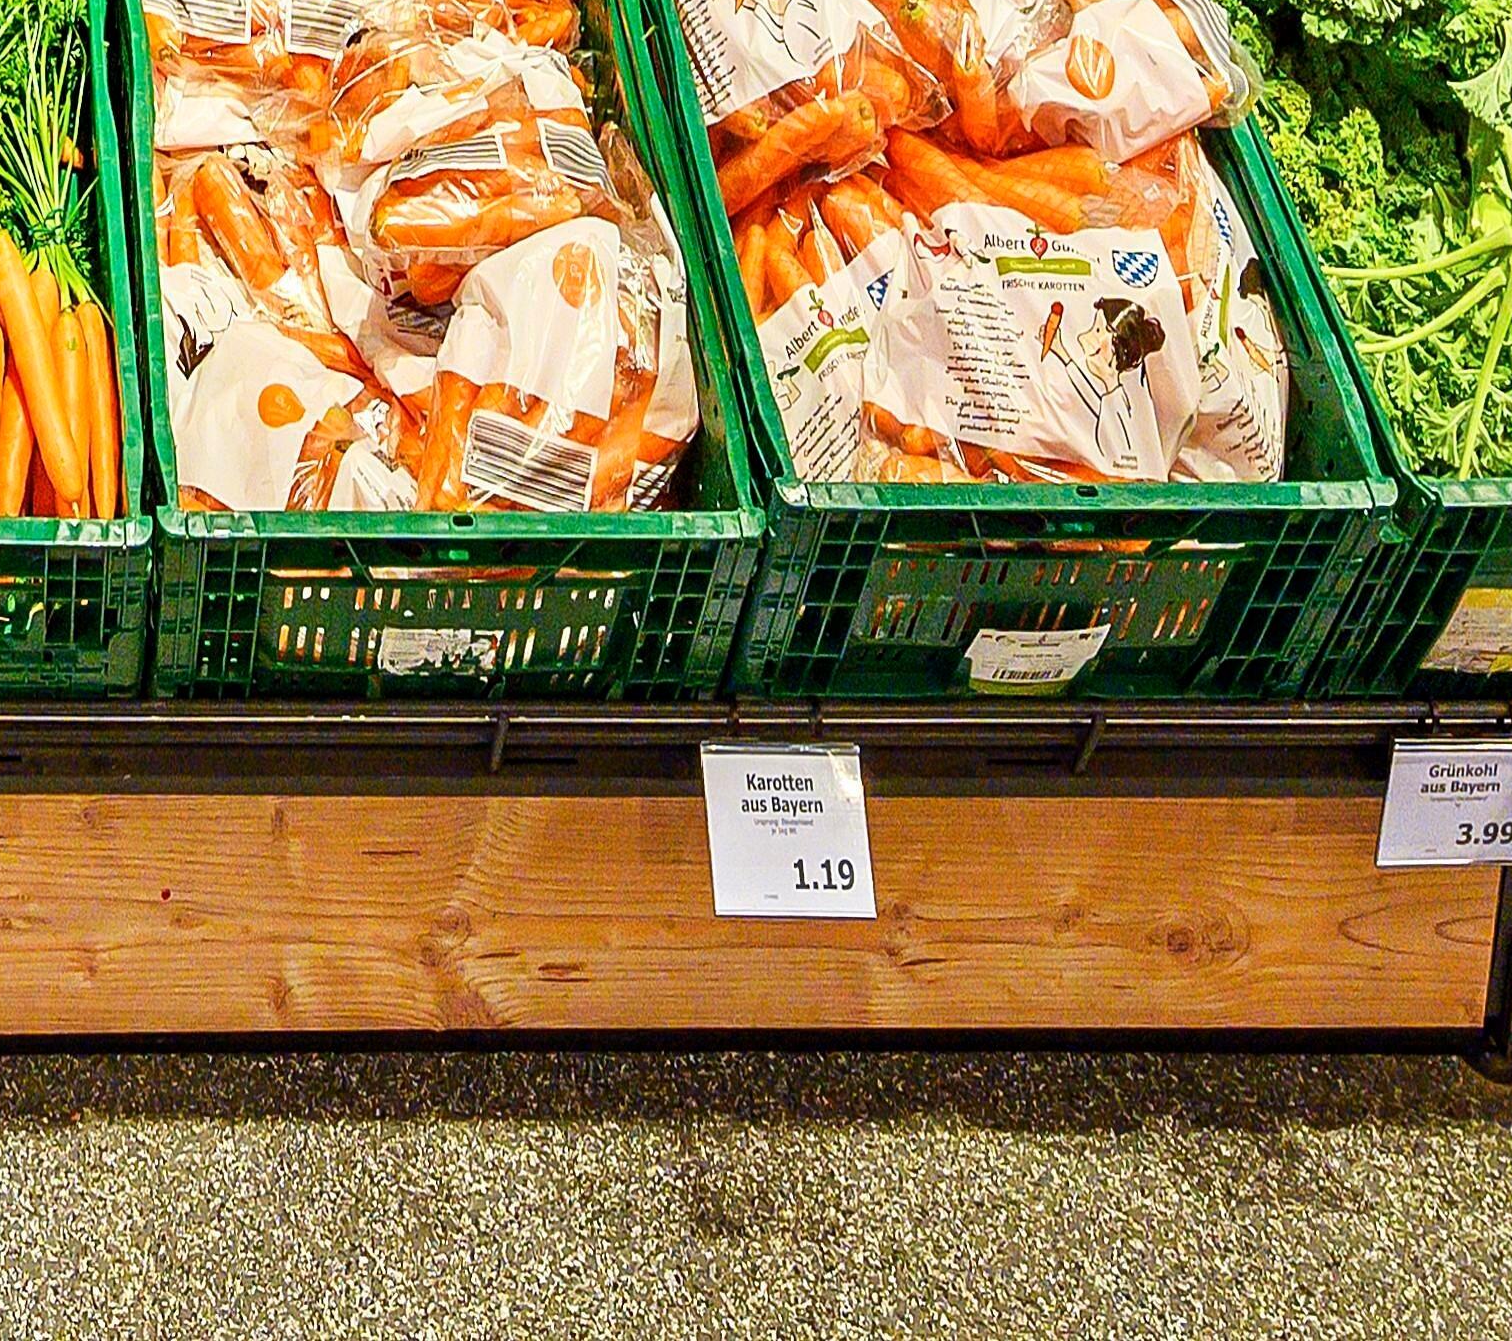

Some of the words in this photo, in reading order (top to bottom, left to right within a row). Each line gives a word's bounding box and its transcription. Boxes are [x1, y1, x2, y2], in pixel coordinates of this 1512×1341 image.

[984, 234, 1026, 251] Albert
[1002, 279, 1035, 290] FRISCHE
[1039, 281, 1085, 291] KAROTTEN
[785, 320, 820, 360] Albert
[1428, 762, 1499, 779] Grünkohl
[746, 773, 814, 792] Karotten
[1420, 783, 1447, 794] aus
[1450, 780, 1501, 796] Bayern
[741, 799, 768, 813] aus
[771, 796, 824, 818] Bayern
[793, 858, 855, 891] 1.19
